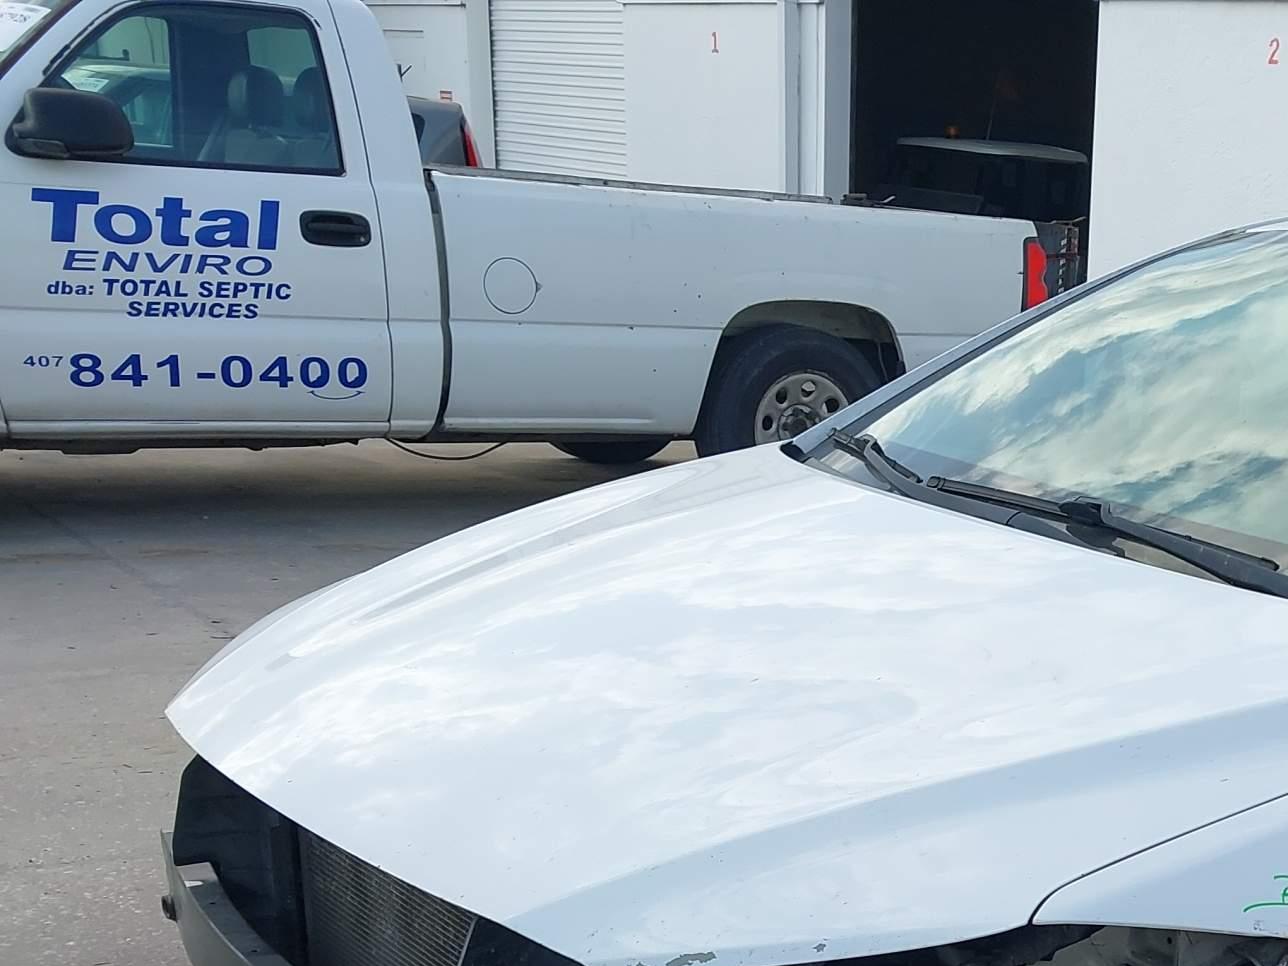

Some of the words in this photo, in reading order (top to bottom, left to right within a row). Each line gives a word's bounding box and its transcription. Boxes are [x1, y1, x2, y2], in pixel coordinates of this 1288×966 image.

[711, 31, 720, 54] 1
[1267, 37, 1280, 65] 2
[31, 187, 281, 251] Total
[62, 249, 273, 277] ENVIRO
[46, 280, 95, 296] dba:
[102, 278, 189, 298] TOTAL
[197, 280, 292, 300] SEPTIC
[126, 301, 260, 320] SERVICES
[23, 355, 64, 368] 407
[69, 353, 368, 389] 841-0400
